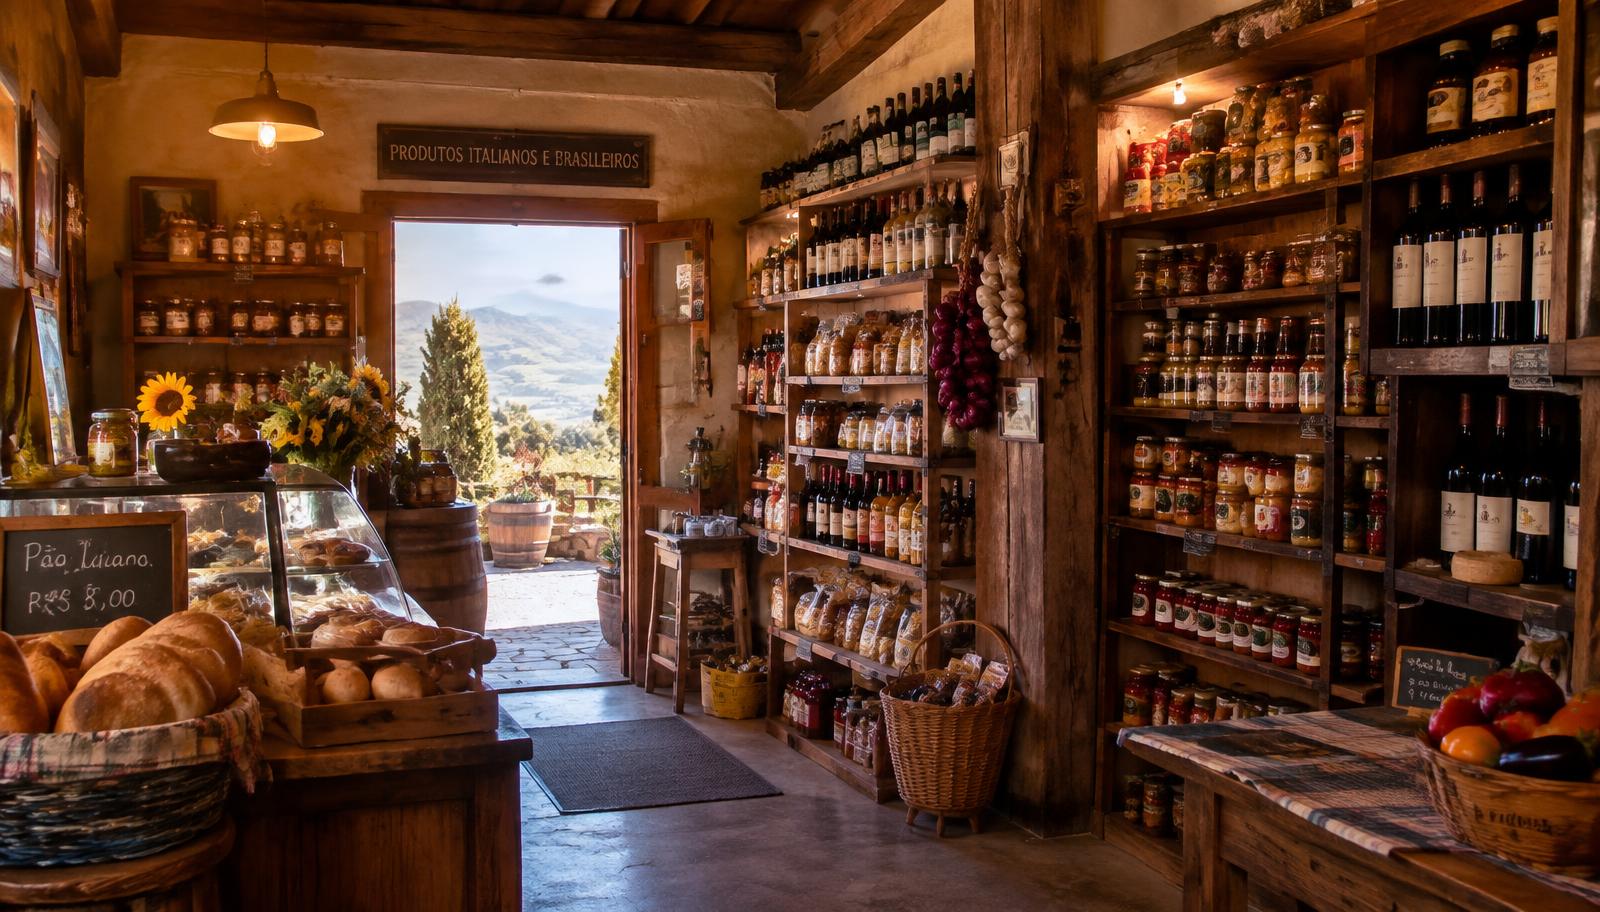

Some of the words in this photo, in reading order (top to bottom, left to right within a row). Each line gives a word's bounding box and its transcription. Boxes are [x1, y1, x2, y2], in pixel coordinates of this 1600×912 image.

[390, 144, 463, 163] PRODUTOS
[469, 147, 538, 166] ITALIANOS
[543, 150, 550, 166] E
